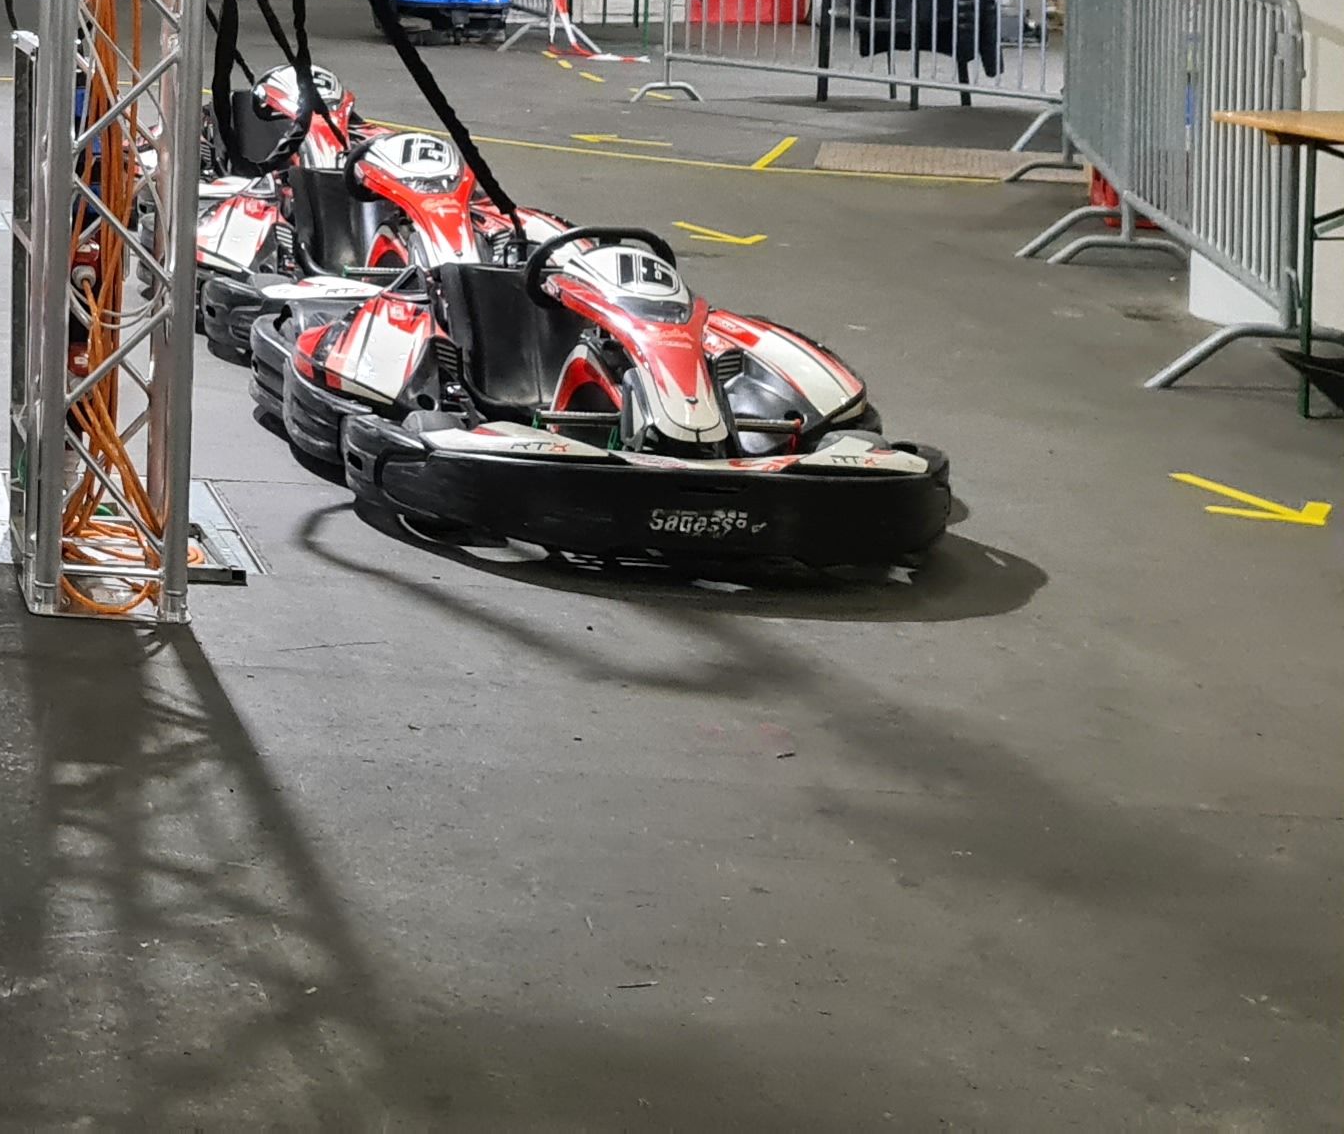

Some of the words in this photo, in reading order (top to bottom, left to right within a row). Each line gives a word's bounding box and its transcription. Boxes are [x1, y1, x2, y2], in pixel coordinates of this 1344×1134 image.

[400, 137, 445, 165] 12
[510, 442, 572, 453] RTX
[830, 454, 878, 467] RTX
